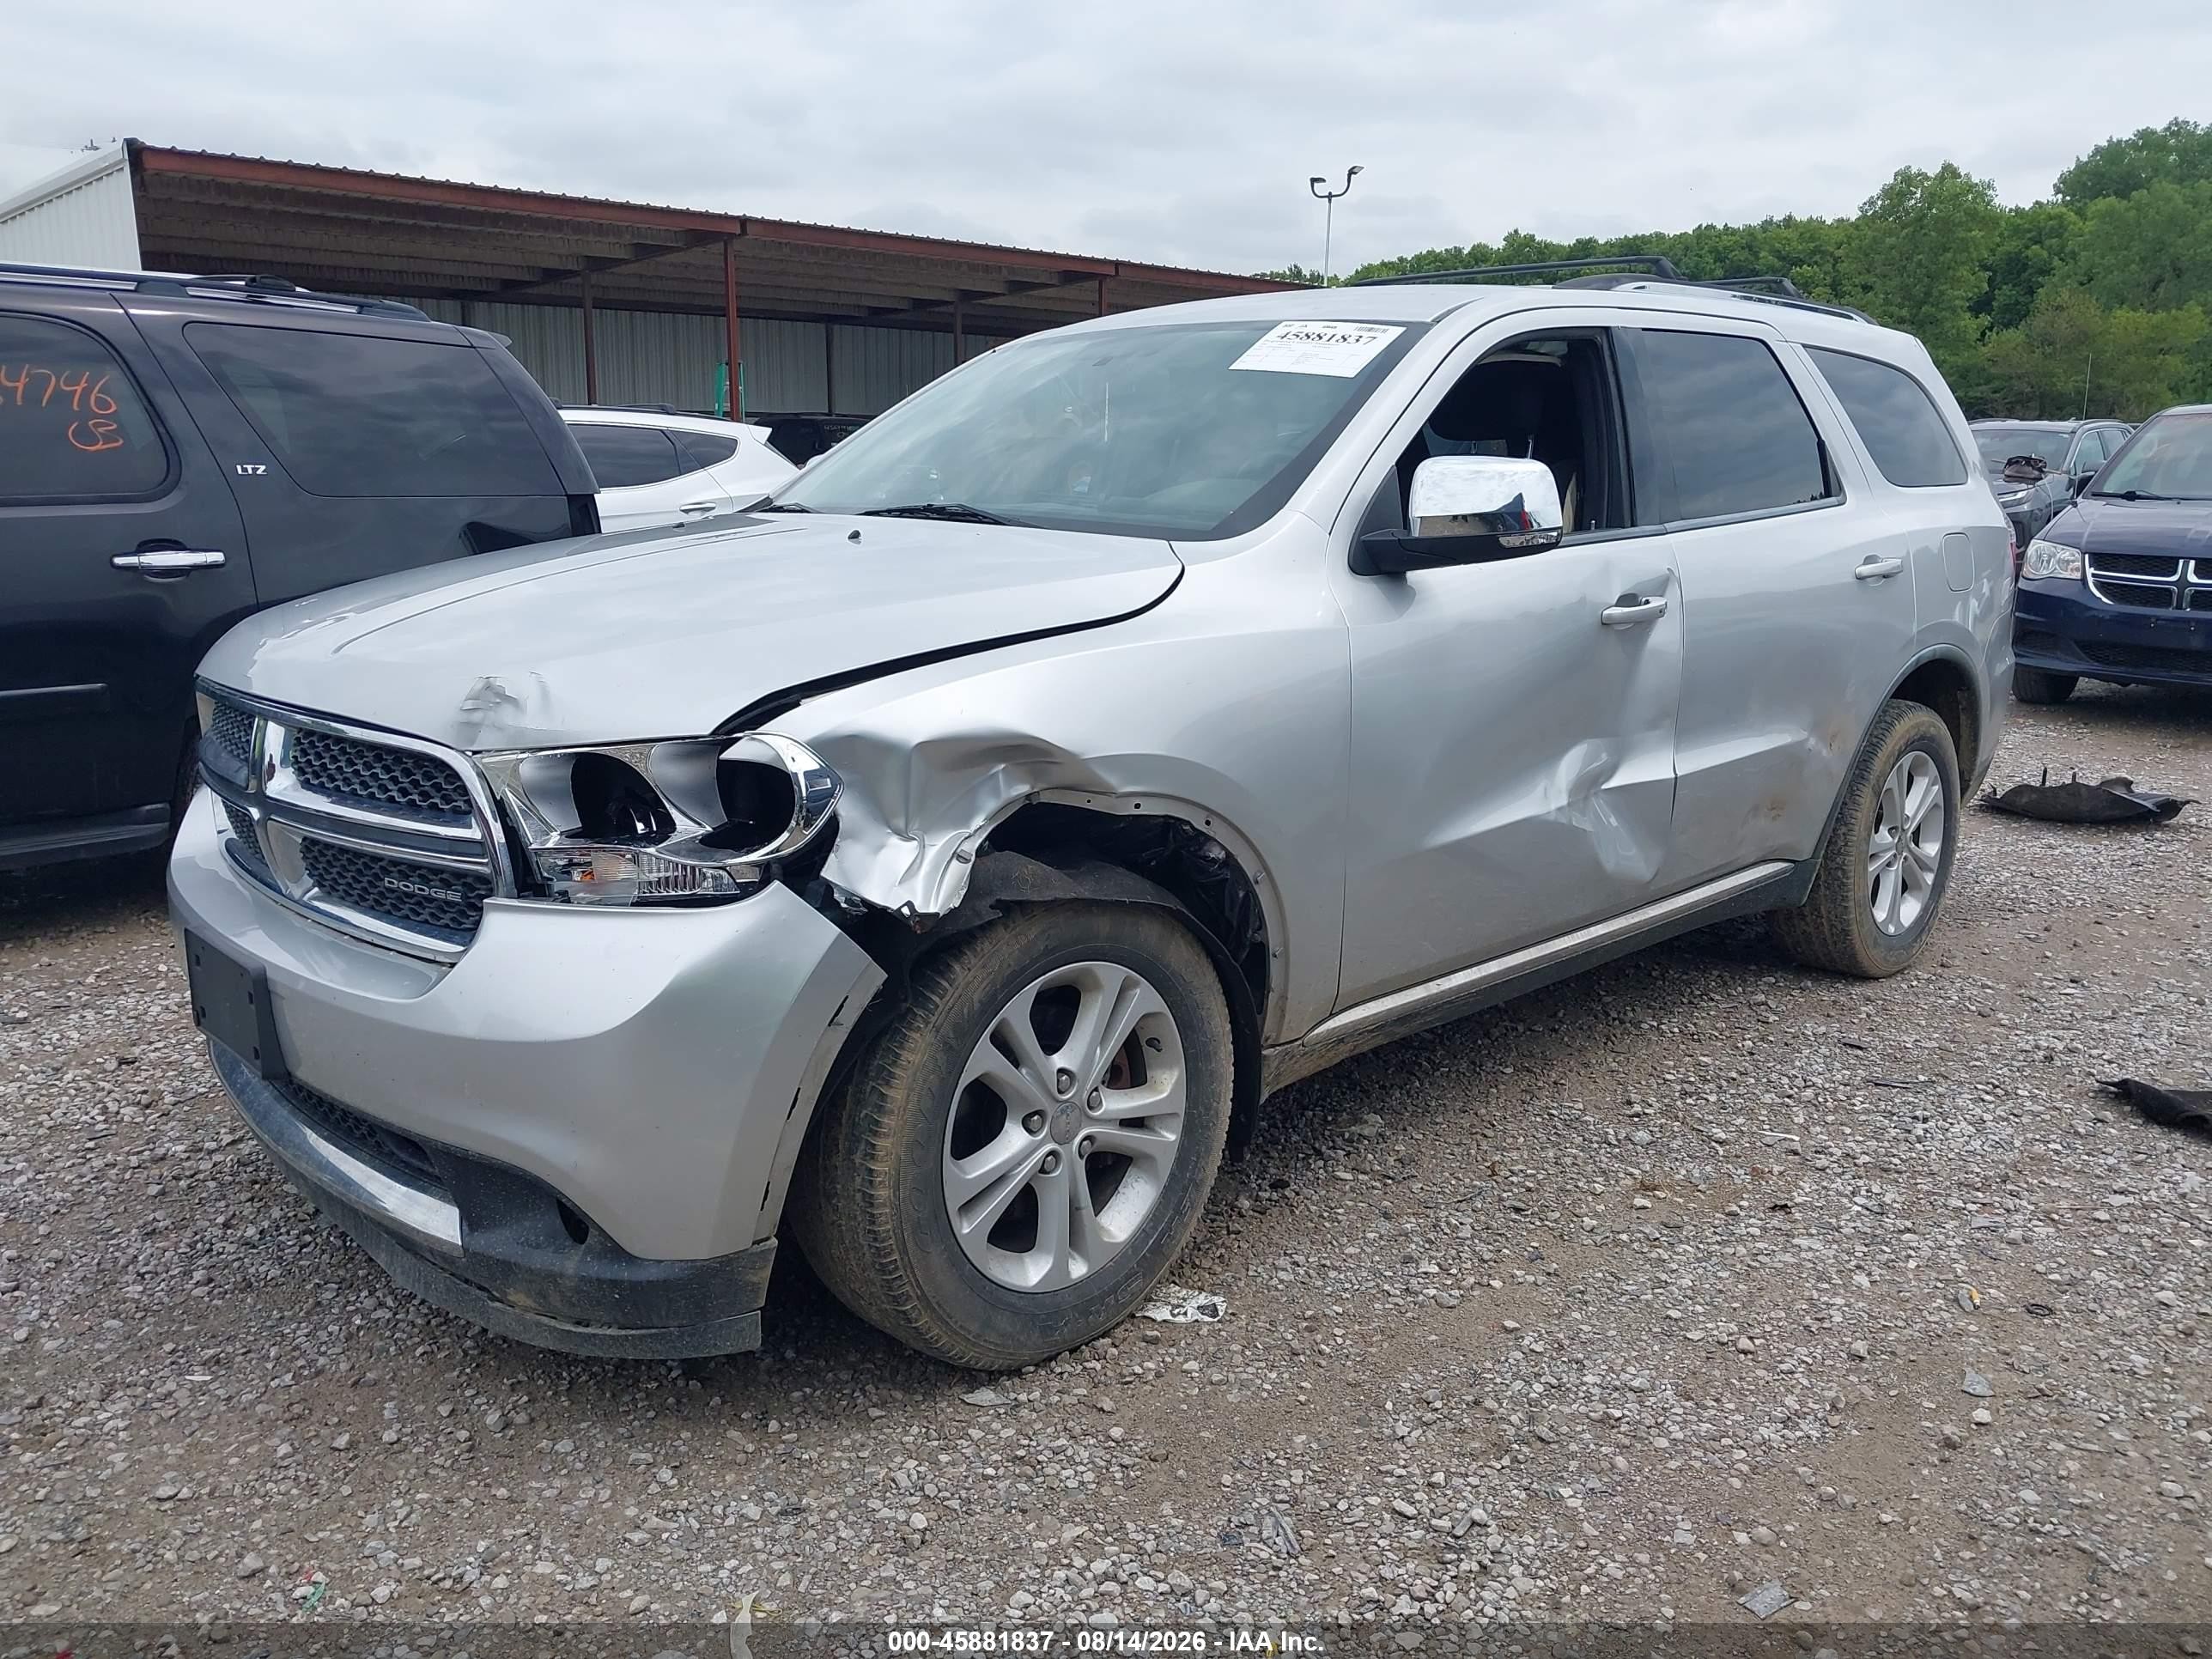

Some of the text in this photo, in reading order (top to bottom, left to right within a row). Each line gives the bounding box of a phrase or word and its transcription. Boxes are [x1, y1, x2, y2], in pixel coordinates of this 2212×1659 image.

[1276, 331, 1377, 345] 45881837
[0, 364, 118, 415] 4746
[235, 464, 268, 475] LTZ
[384, 877, 462, 902] DODGE
